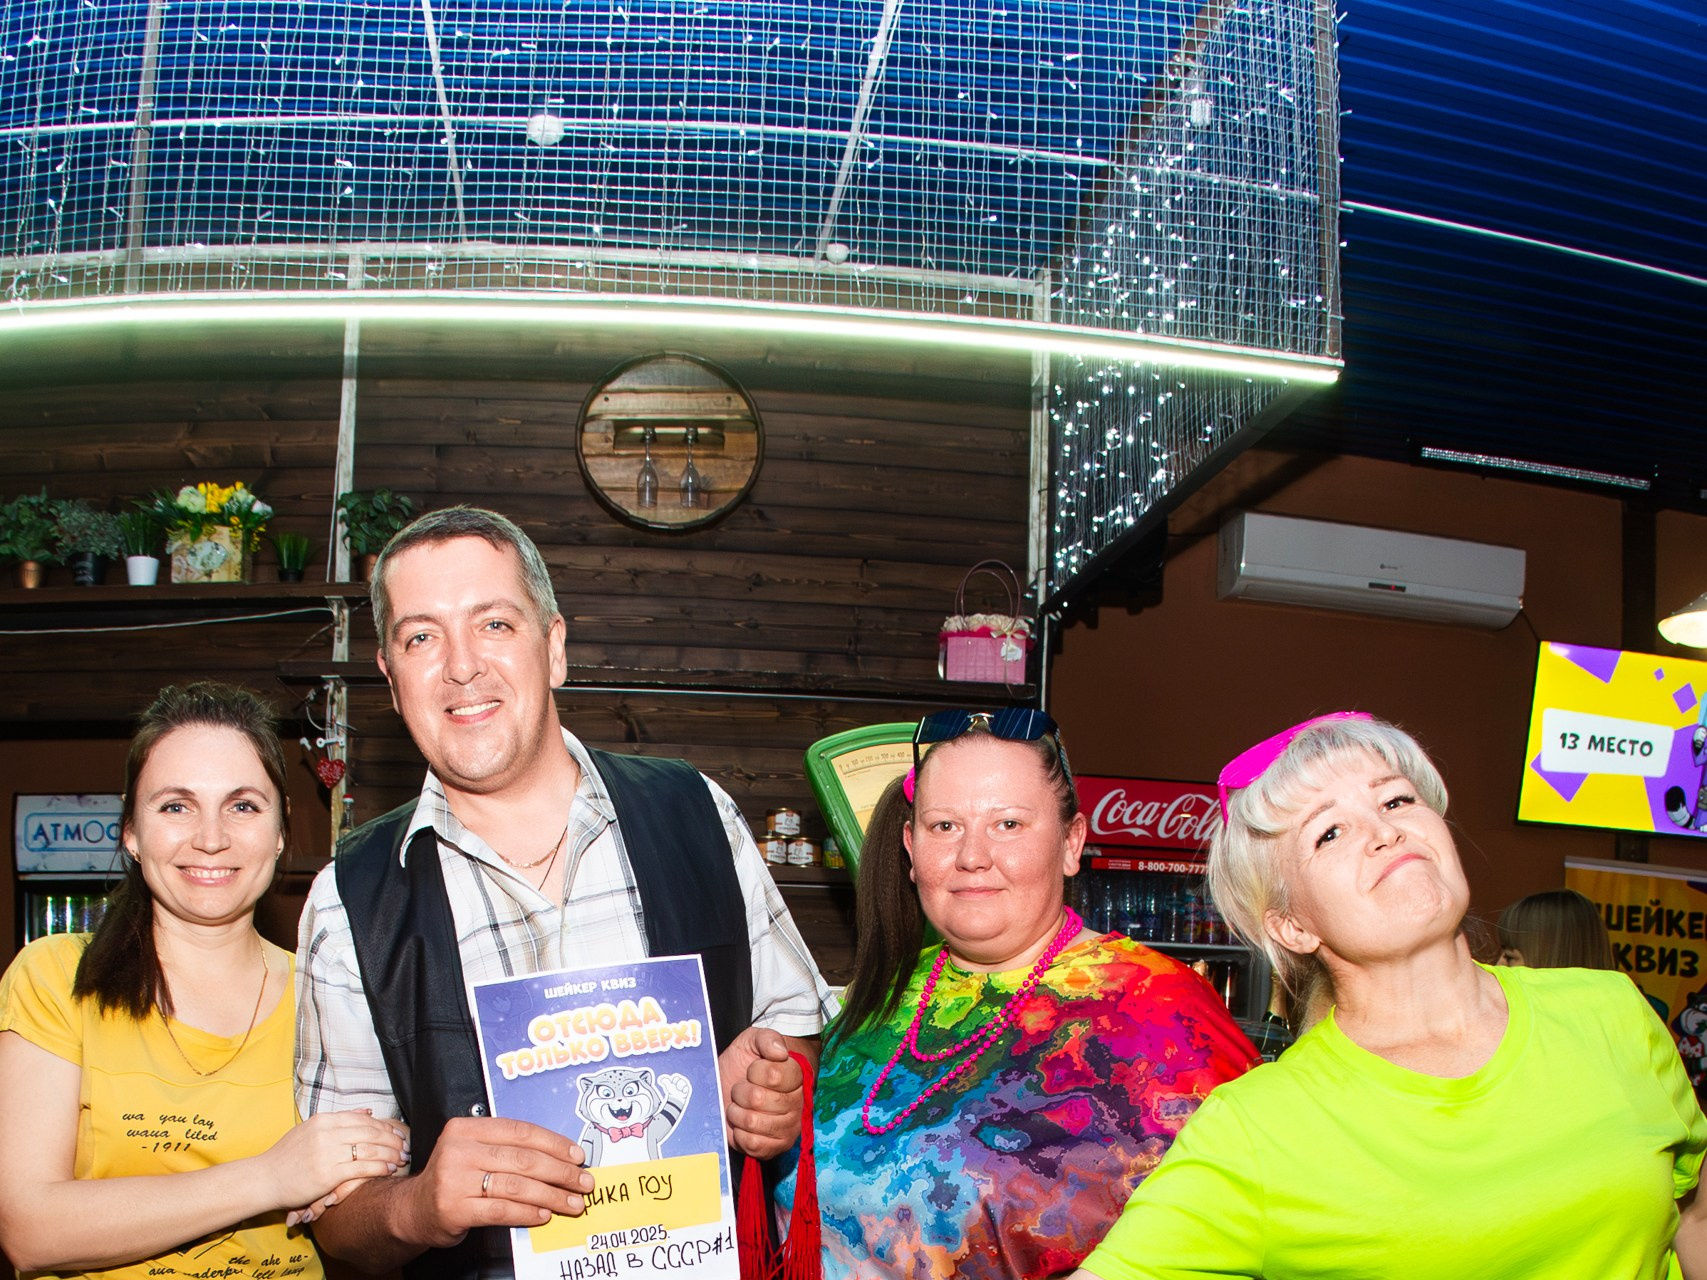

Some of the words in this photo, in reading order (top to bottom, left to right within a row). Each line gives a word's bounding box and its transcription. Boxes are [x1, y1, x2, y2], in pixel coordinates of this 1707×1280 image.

[1560, 732, 1580, 750] 13
[1588, 735, 1654, 757] МЕСТО
[1138, 861, 1209, 875] 8-800-700-777
[1597, 899, 1707, 940] ШЕЙКЕ
[1612, 942, 1699, 978] КВИЗ
[544, 981, 597, 999] ШЕЙКЕР
[601, 977, 637, 991] КВИЗ
[533, 1001, 662, 1042] ОТСЮДА
[501, 1037, 605, 1076] ТОЛЬКО
[614, 1022, 698, 1054] ВВЕРХ!
[627, 1253, 643, 1268] В
